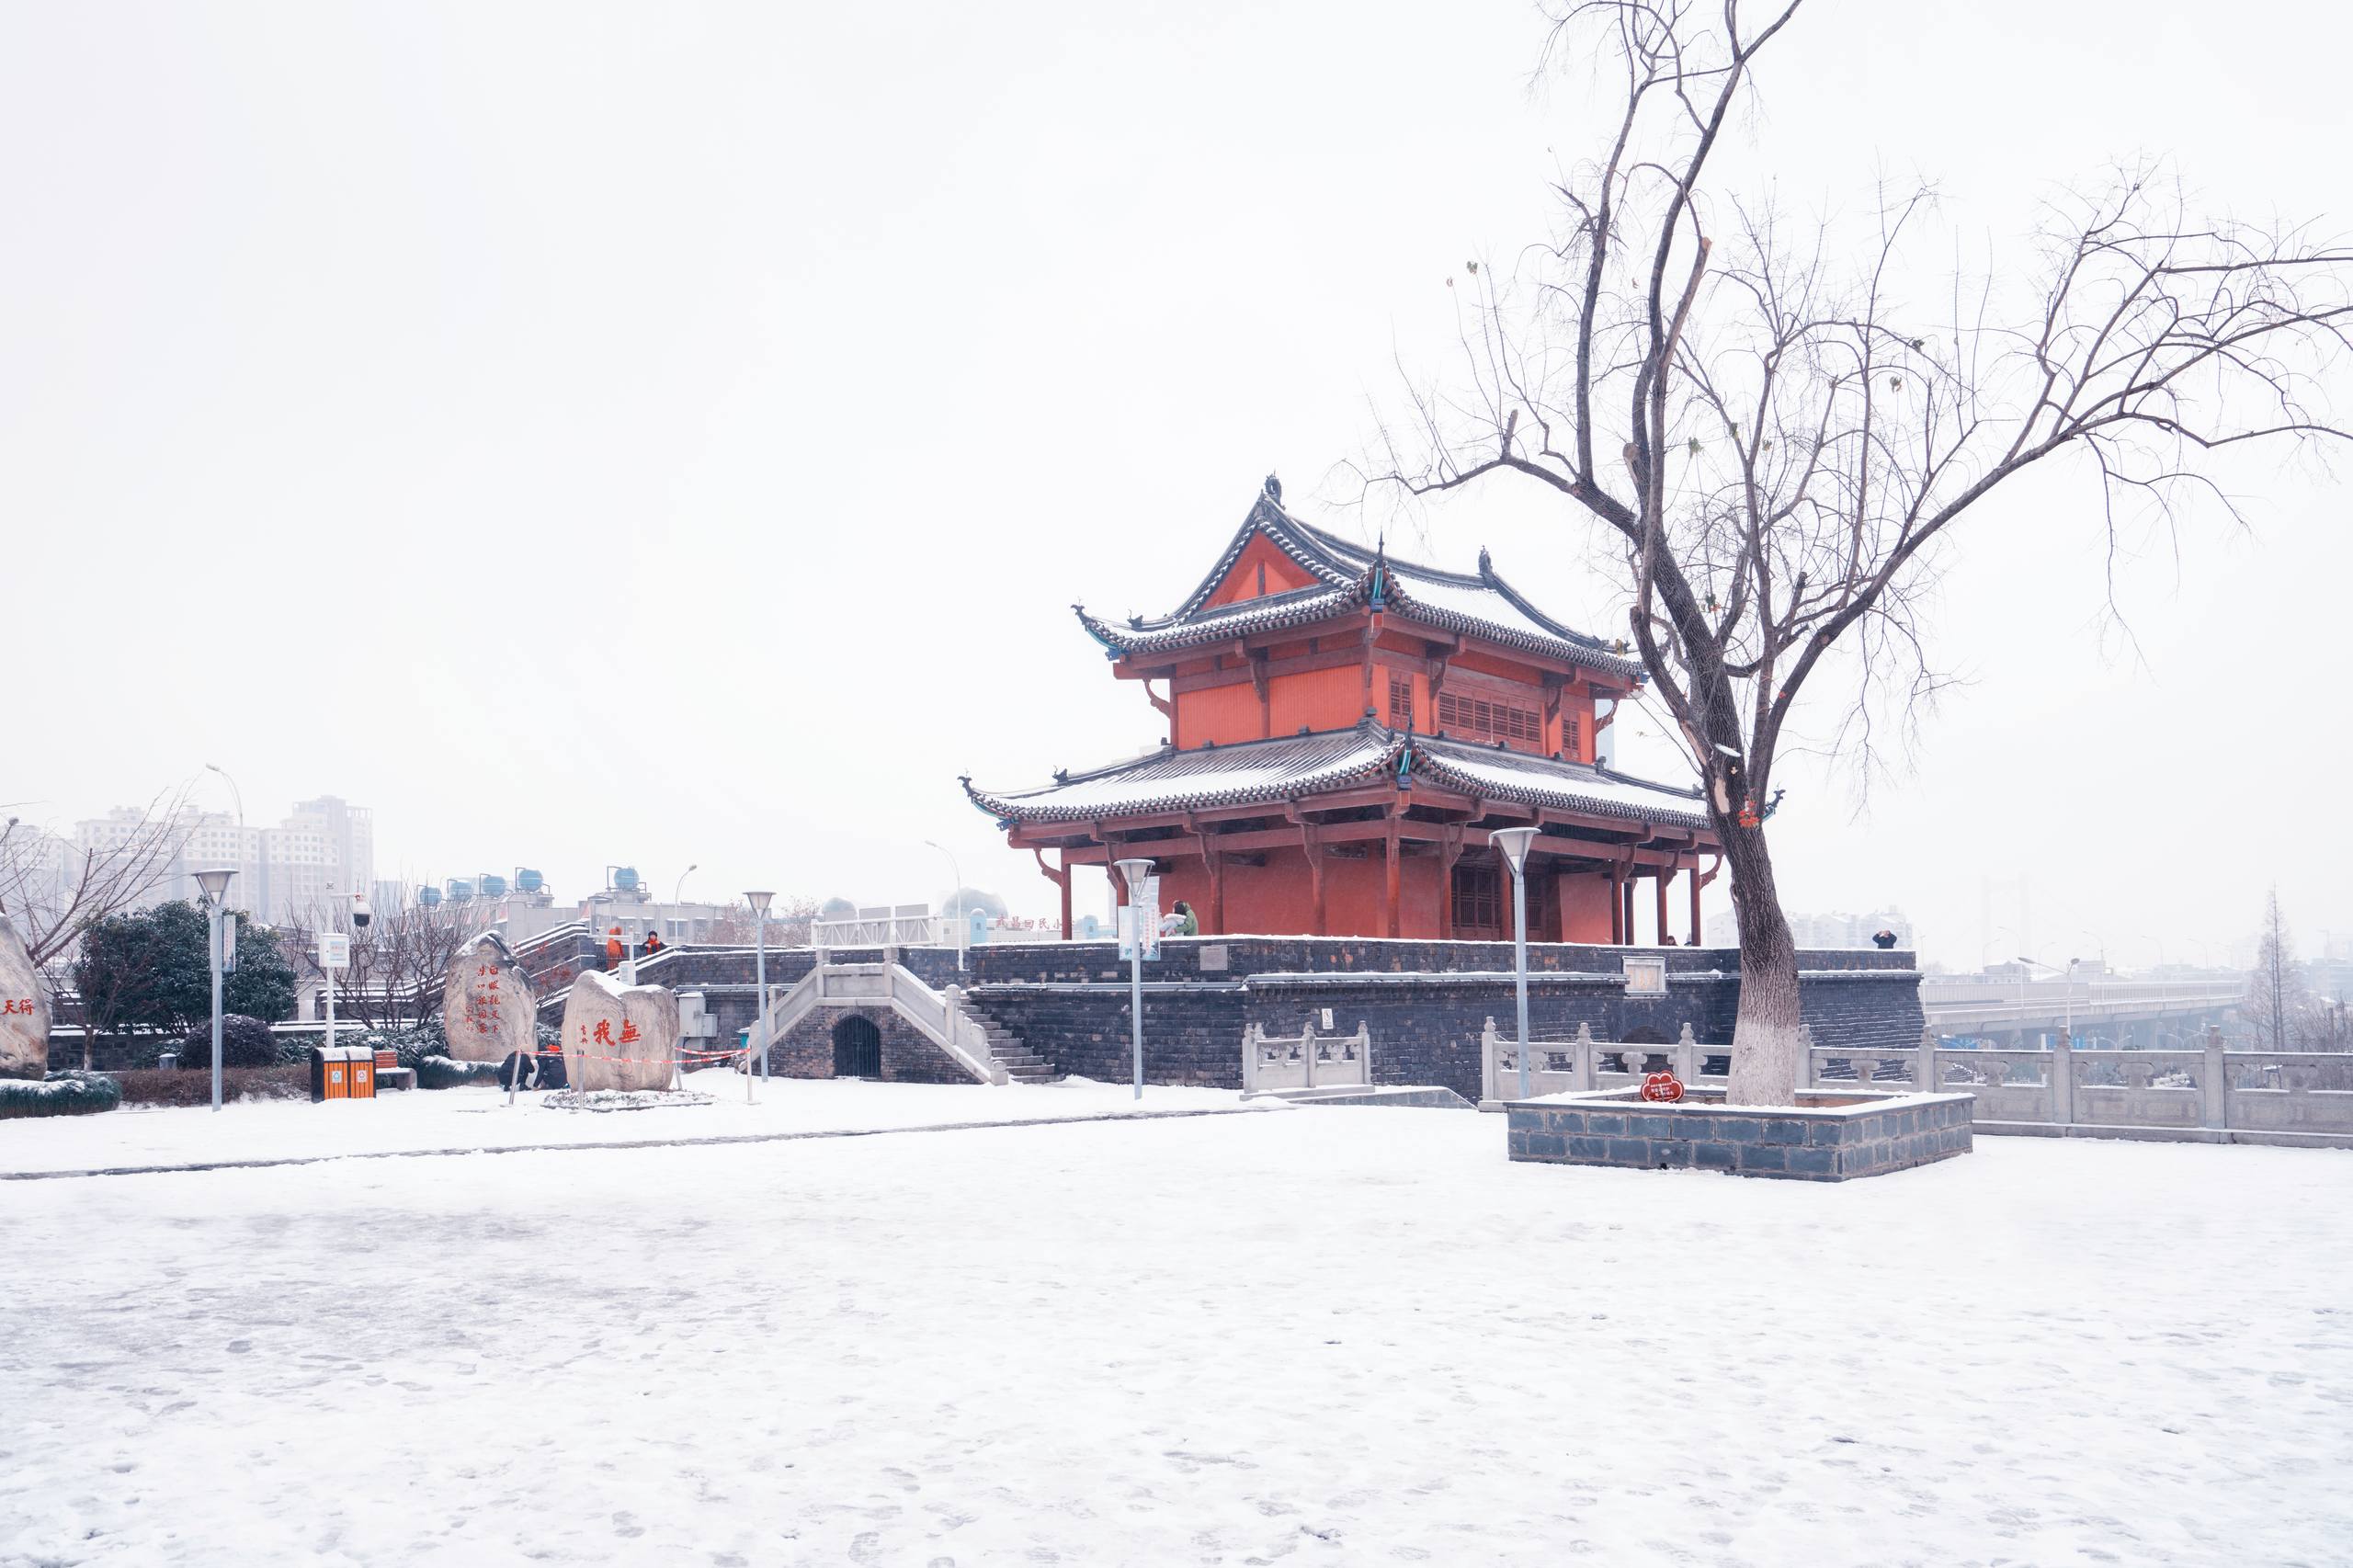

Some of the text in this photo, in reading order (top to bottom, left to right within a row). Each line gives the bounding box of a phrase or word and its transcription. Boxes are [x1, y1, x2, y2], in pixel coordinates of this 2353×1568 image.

[995, 914, 1074, 930] 武昌回民小
